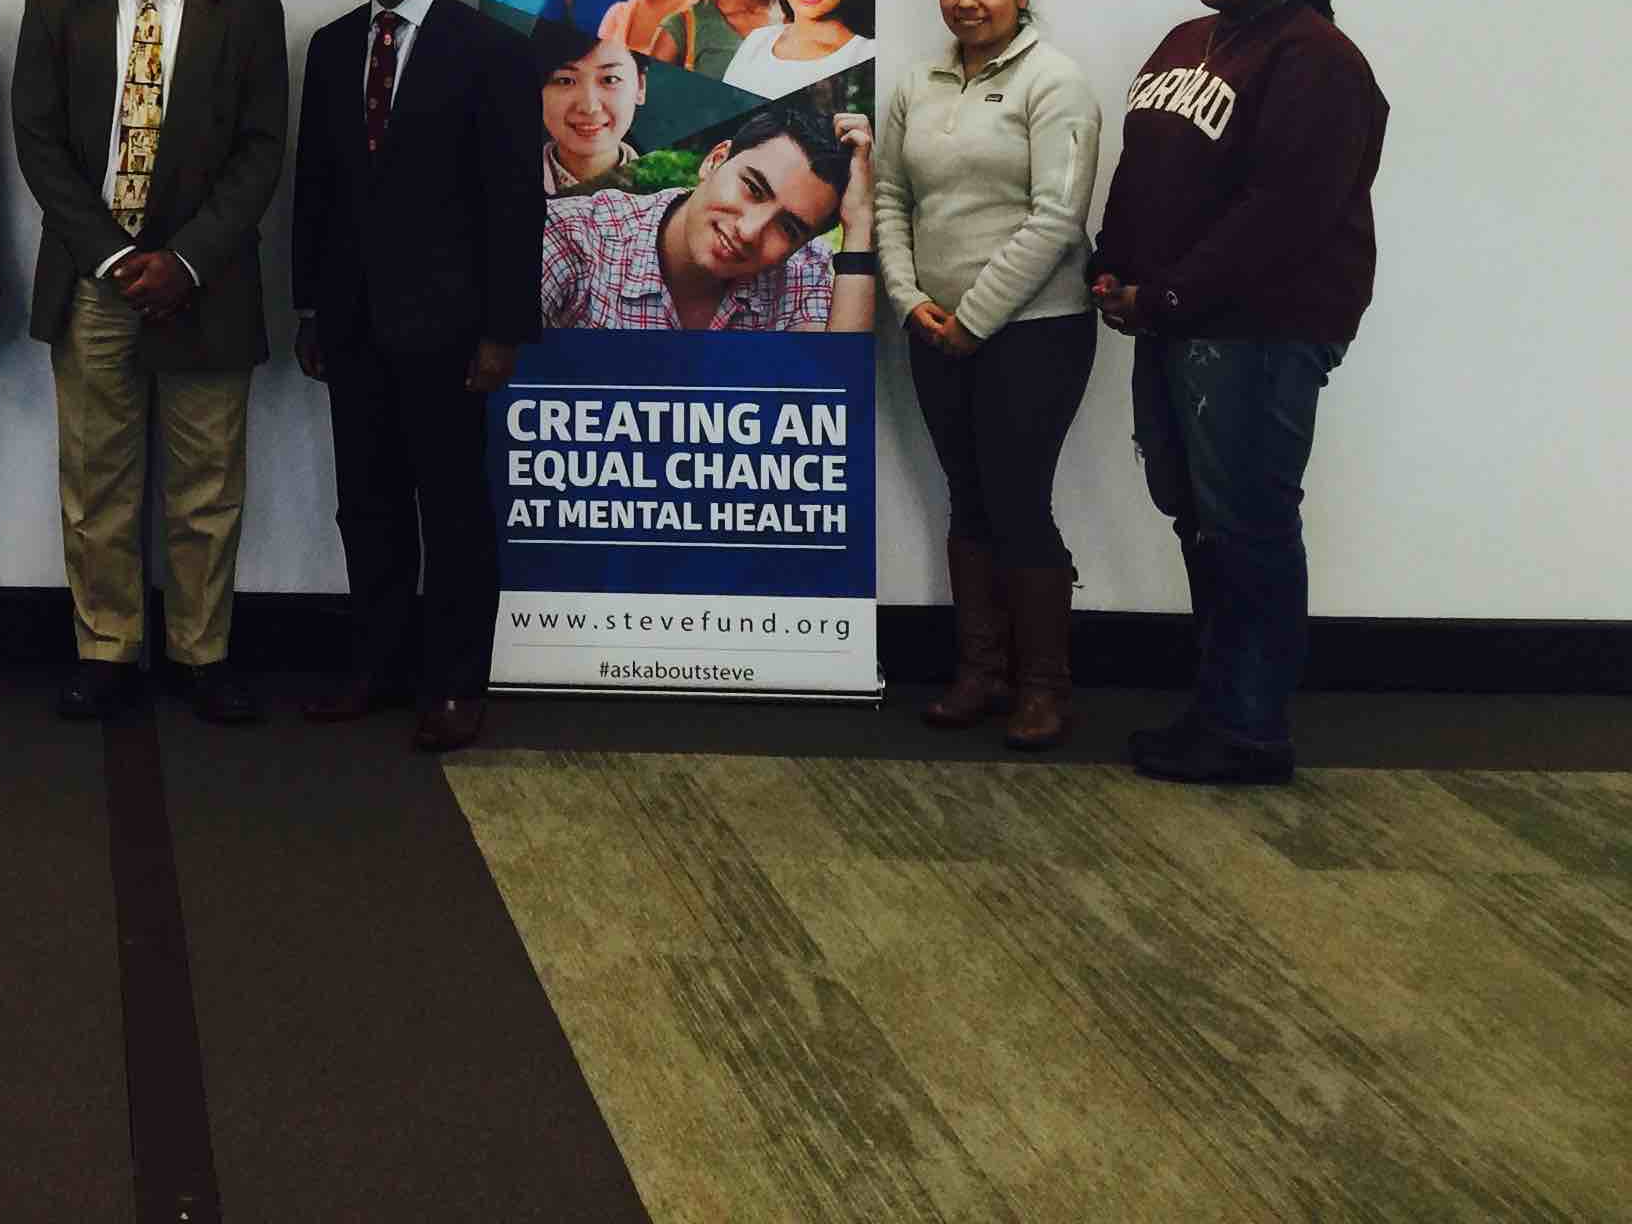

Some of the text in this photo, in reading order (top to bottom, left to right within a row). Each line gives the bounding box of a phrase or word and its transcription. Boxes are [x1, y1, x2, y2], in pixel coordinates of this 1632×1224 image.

[506, 399, 847, 446] CREATING AN
[508, 449, 847, 492] EQUAL CHANCE
[506, 498, 846, 534] AT MENTAL HEALTH
[511, 610, 850, 640] www.stevefund.org
[599, 660, 755, 682] #askaboutsteve
